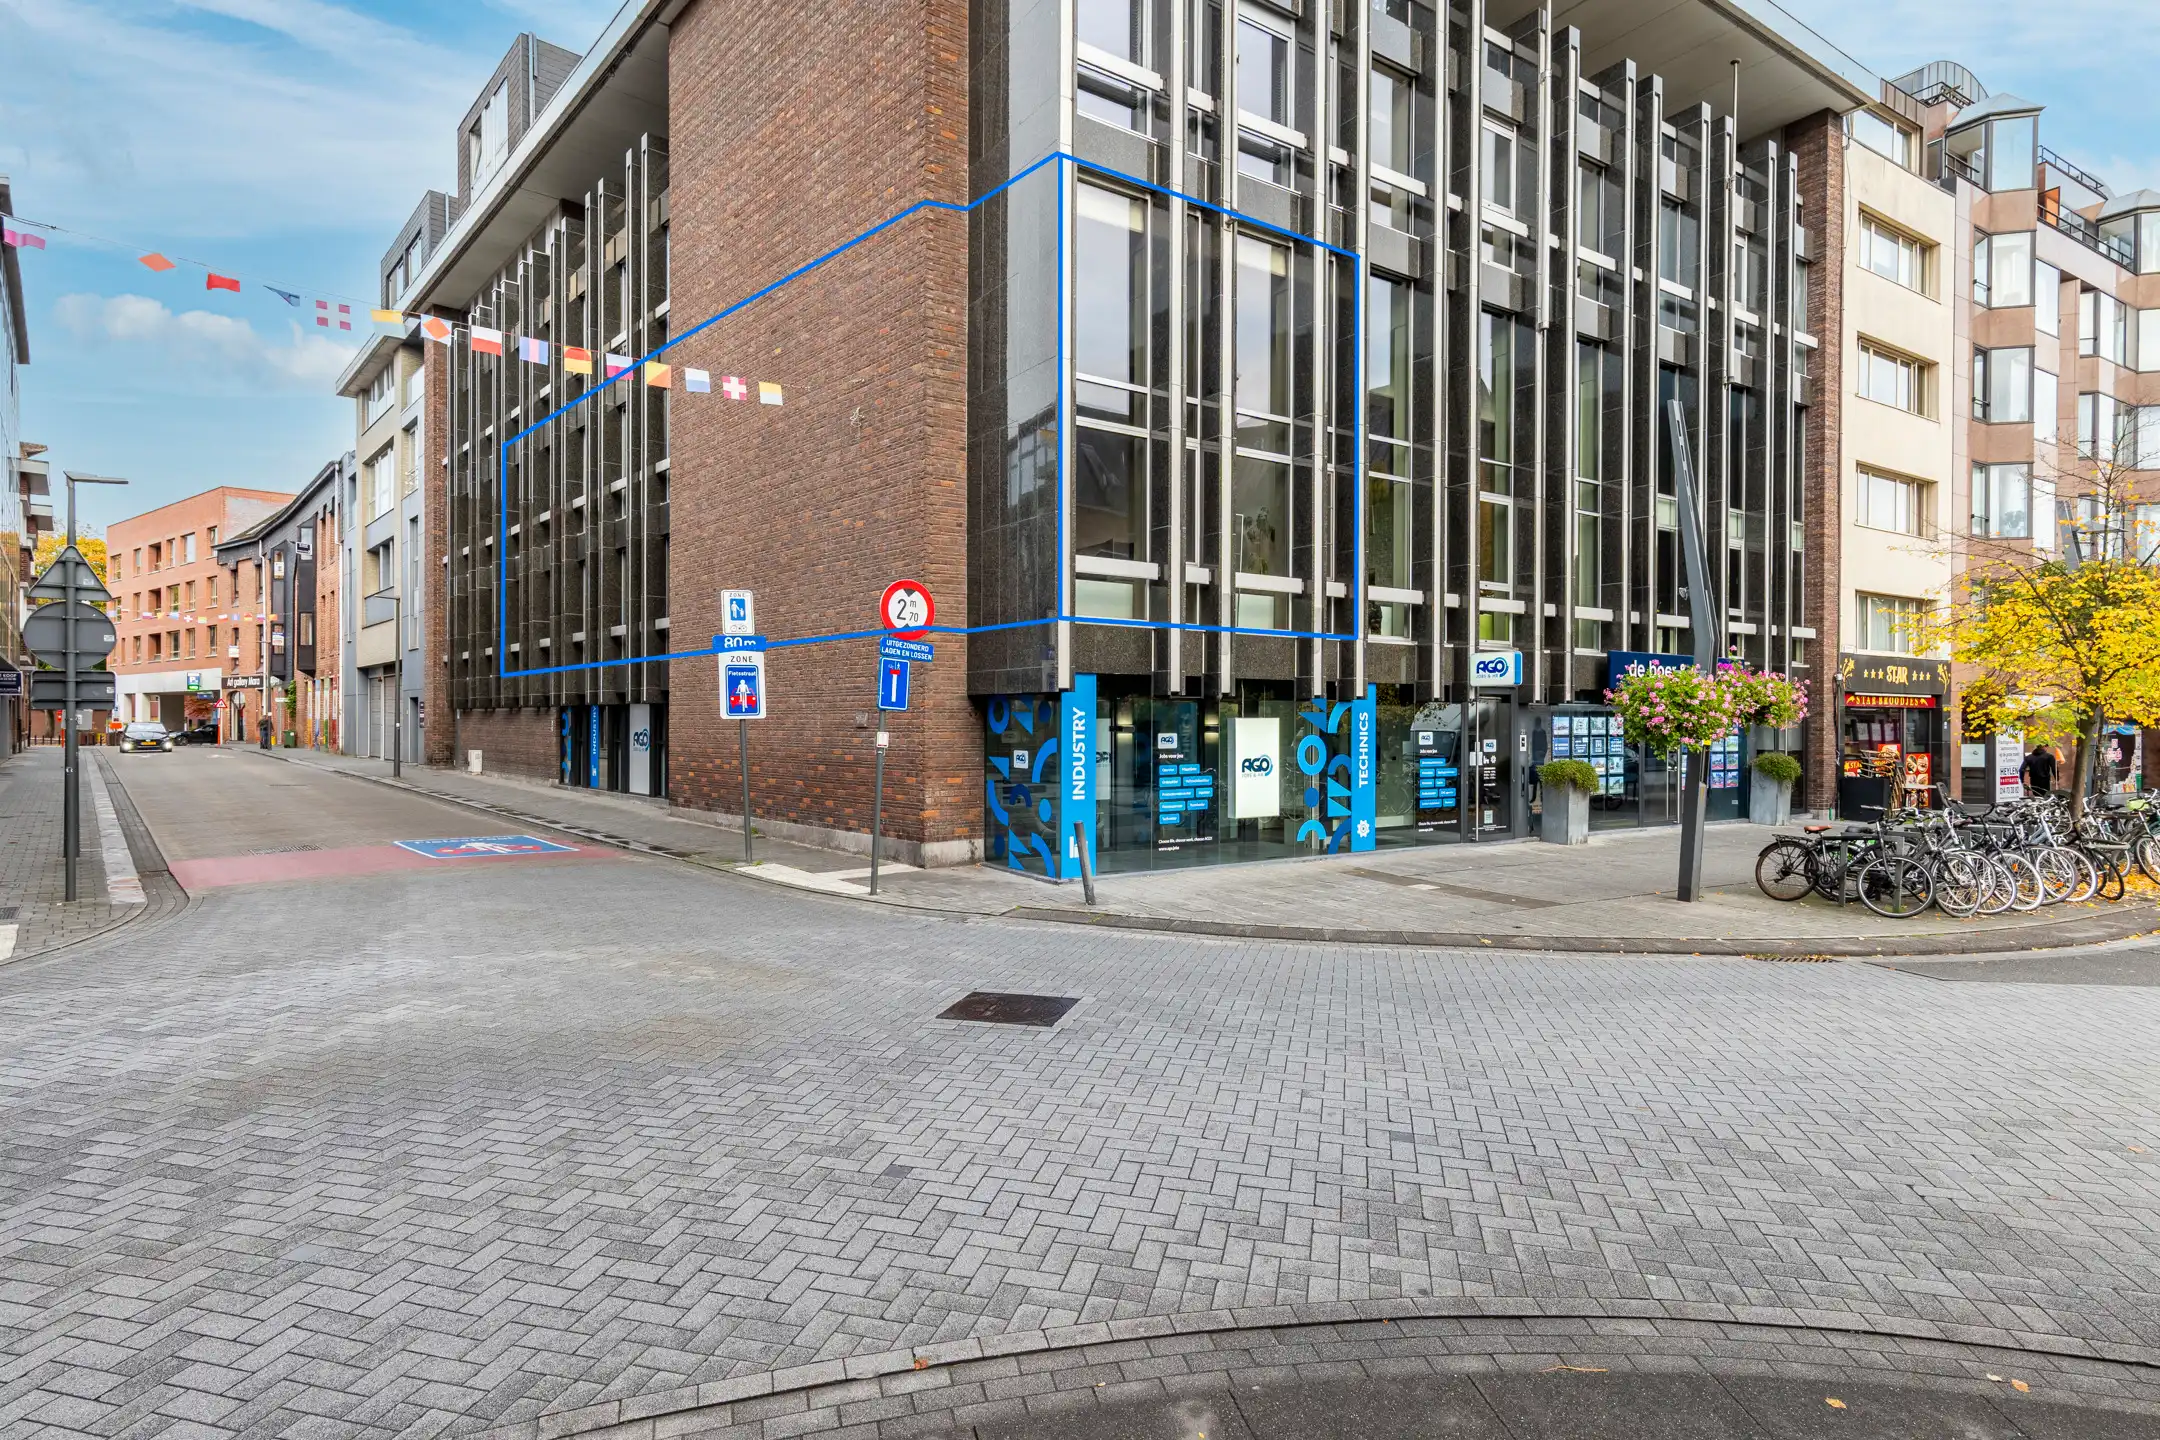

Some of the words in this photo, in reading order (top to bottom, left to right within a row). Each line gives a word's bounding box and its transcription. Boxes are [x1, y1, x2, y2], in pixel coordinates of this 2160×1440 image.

[896, 598, 907, 620] 2
[909, 612, 918, 622] 70
[882, 647, 900, 656] LADEN
[910, 652, 932, 660] LOSSEN
[886, 640, 929, 652] UITGEZONDERD
[1476, 659, 1506, 674] AGO
[1628, 660, 1645, 678] de
[234, 677, 248, 688] gallery
[1886, 665, 1908, 686] STAR
[1856, 696, 1876, 705] STAR
[1878, 696, 1919, 706] BROODJES
[633, 730, 649, 746] AGO
[1072, 707, 1086, 800] INDUSTRY
[1359, 712, 1369, 788] TECHNICS
[1242, 756, 1271, 773] AGO
